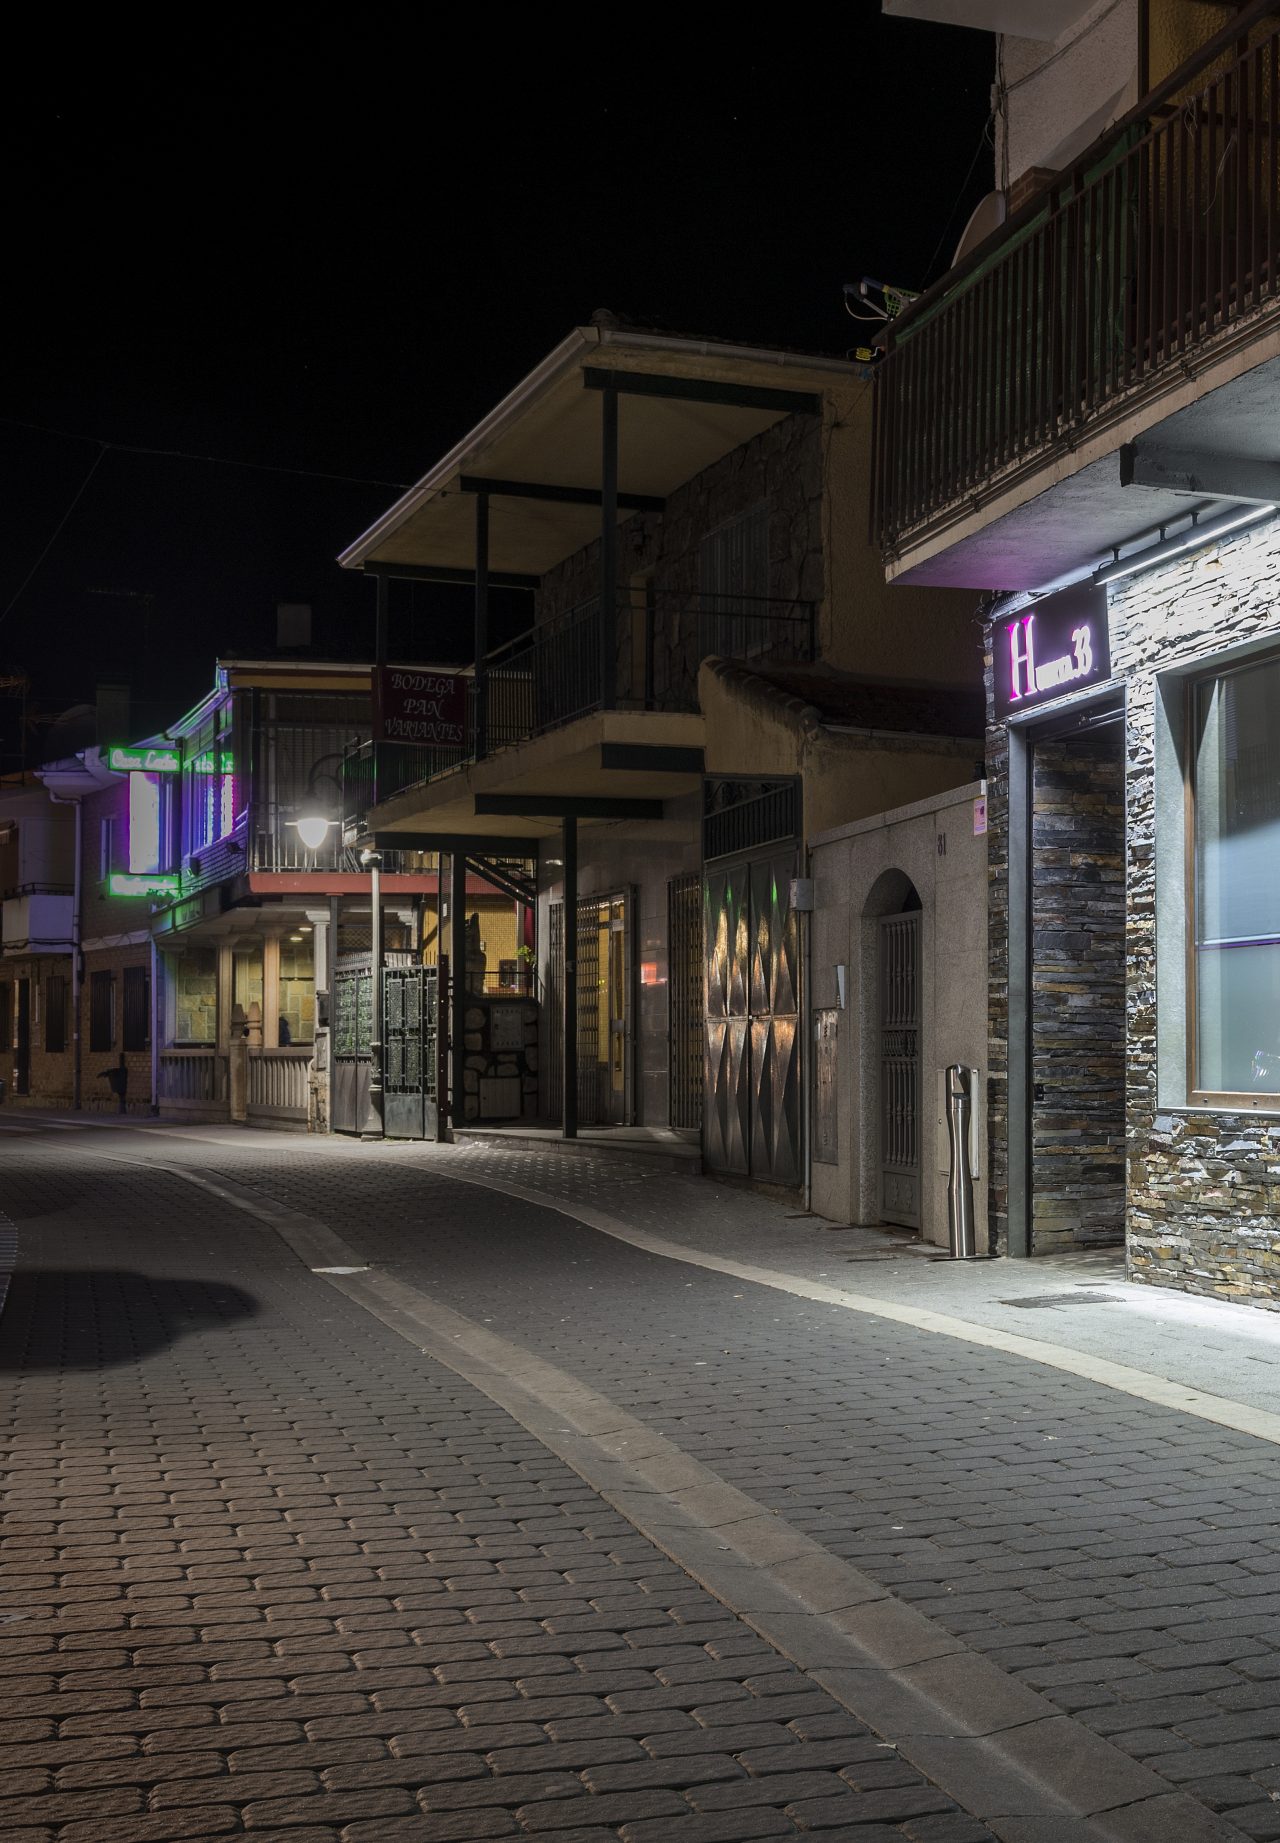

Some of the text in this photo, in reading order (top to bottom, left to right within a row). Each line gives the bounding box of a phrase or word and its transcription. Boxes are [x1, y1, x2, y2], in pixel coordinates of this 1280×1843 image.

[391, 673, 456, 698] BODEGA
[403, 698, 445, 720] PAN
[385, 716, 464, 742] VARIANTES
